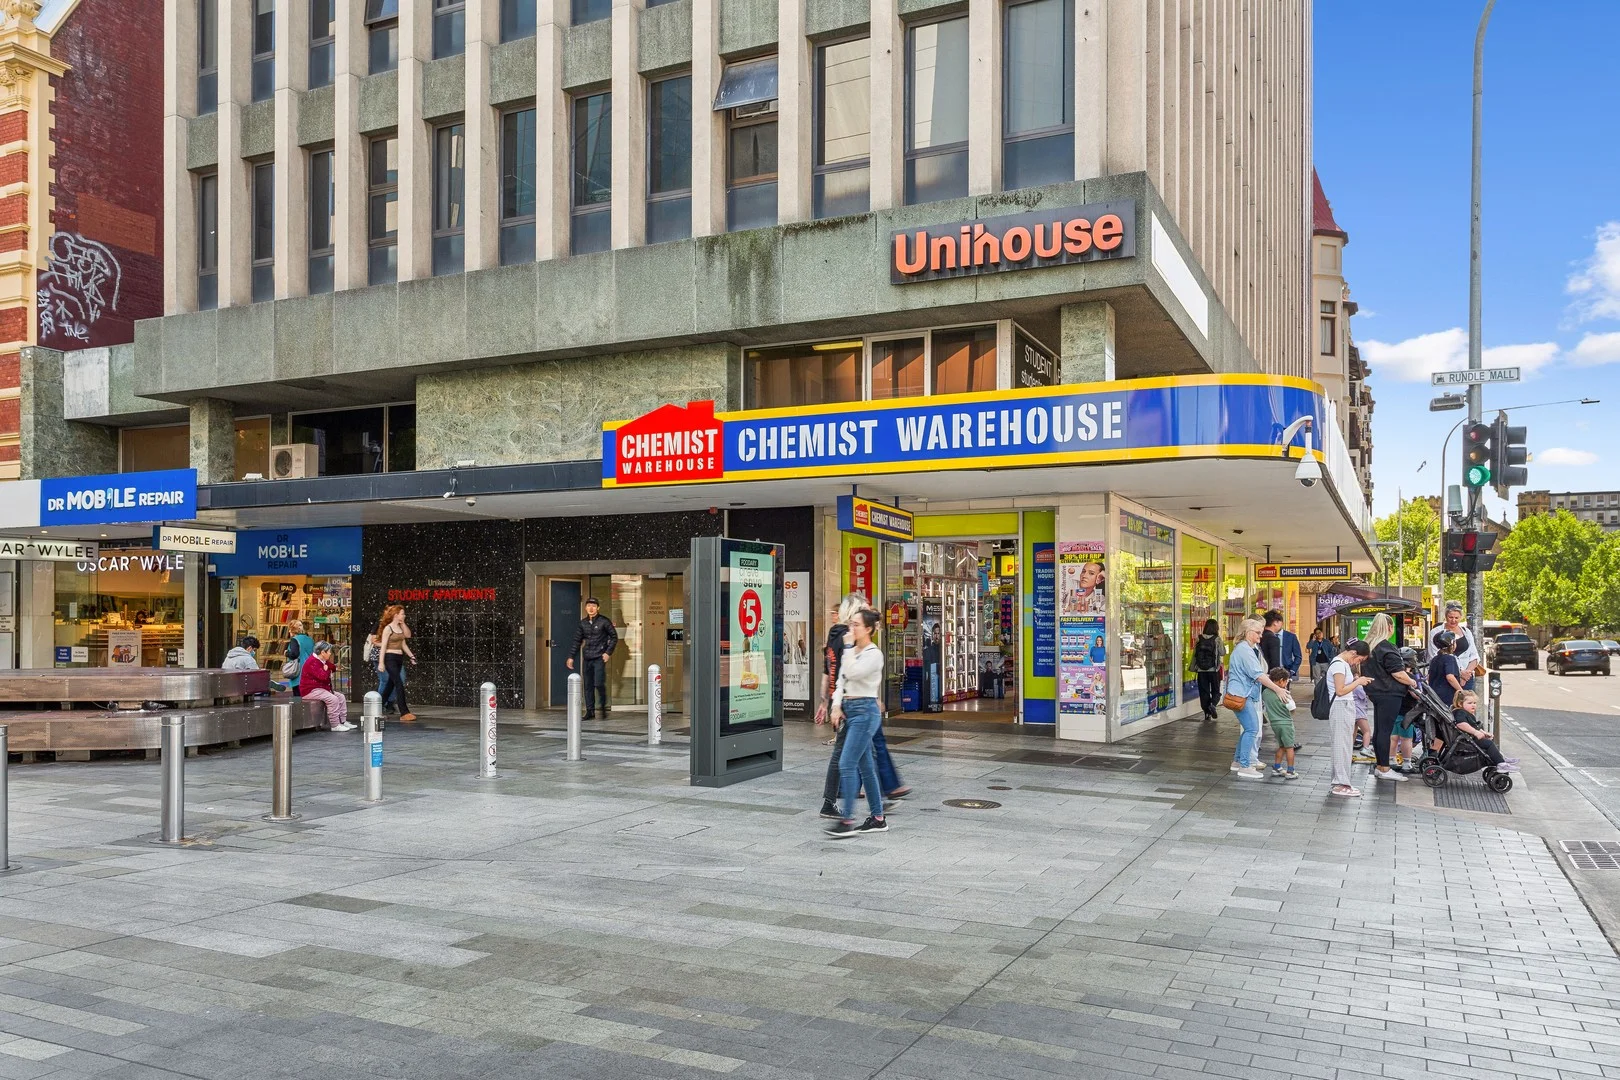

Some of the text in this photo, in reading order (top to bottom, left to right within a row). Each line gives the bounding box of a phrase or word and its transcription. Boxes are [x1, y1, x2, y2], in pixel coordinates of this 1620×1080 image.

[895, 213, 1124, 275] Unihouse
[1024, 344, 1052, 378] STUDENT
[1449, 370, 1514, 382] RUNDLE MALL
[738, 401, 1122, 462] CHEMIST WAREHOUSE
[622, 428, 718, 458] CHEMIST
[622, 457, 714, 474] WAREHOUSE
[48, 488, 184, 511] DR MOBILE REPAIR
[872, 510, 912, 532] CHEMIST WAREHOUSE
[173, 534, 210, 546] MOBILE
[276, 534, 288, 542] DR
[38, 544, 94, 558] WYLEE
[258, 544, 308, 559] MOBILE
[268, 560, 298, 569] REPAIR
[1309, 567, 1346, 575] WAREHOUSE
[388, 588, 496, 600] STUDENT APARTMENTS
[318, 597, 351, 607] MOBILE
